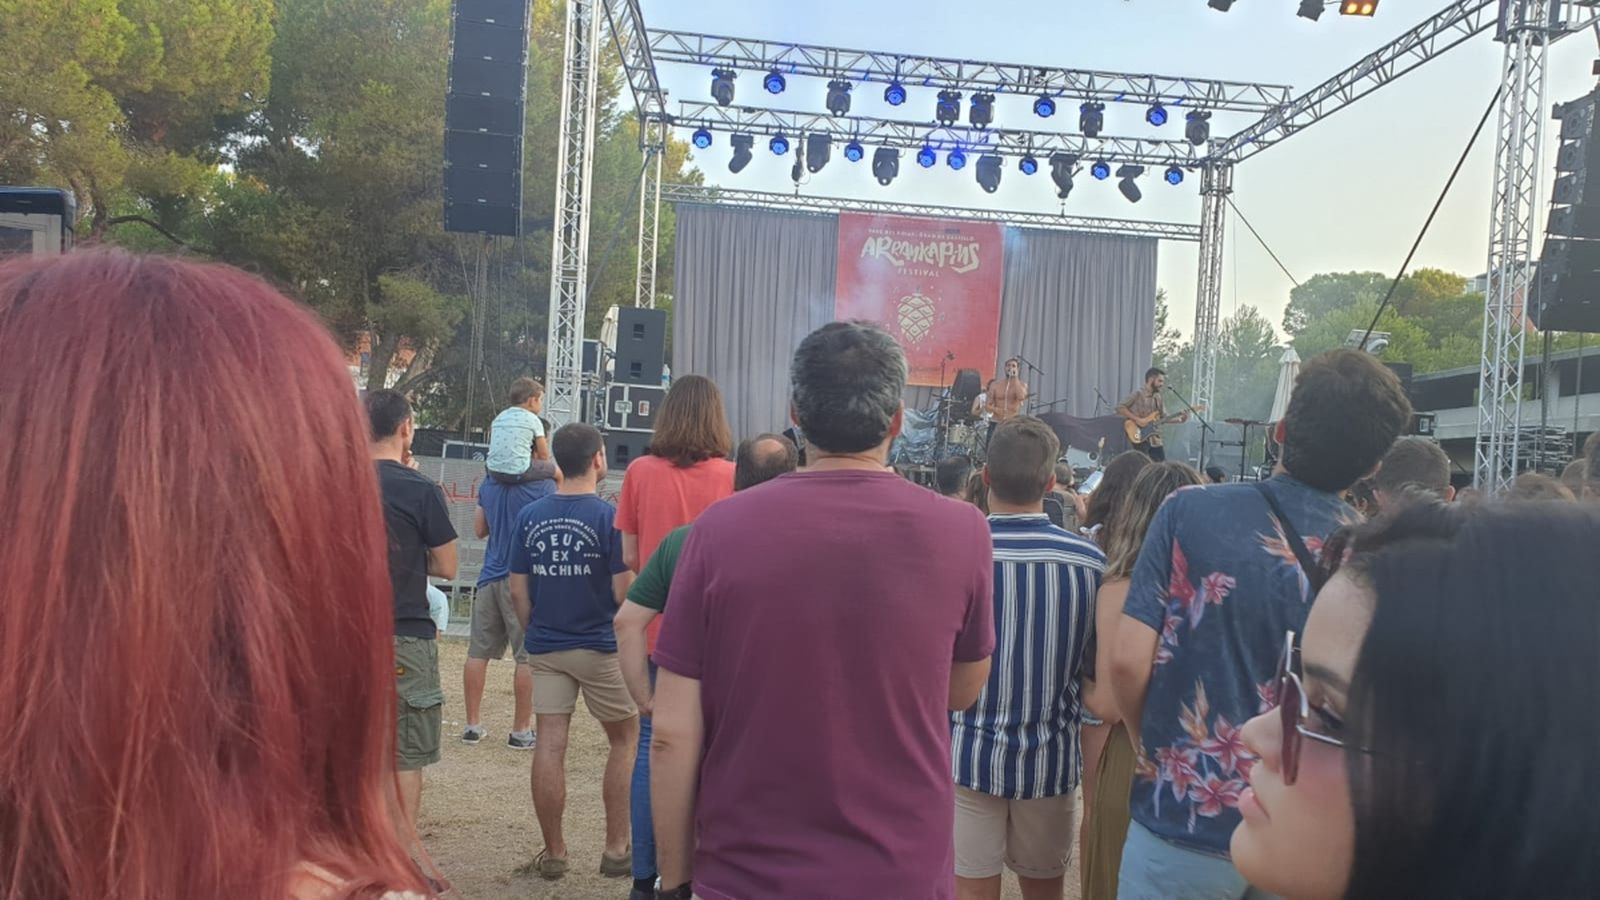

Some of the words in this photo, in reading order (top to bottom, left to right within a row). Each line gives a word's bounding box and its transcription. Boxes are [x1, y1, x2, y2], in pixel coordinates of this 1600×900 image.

[897, 267, 940, 278] FESTIVAL
[536, 533, 585, 553] DEUS
[552, 550, 569, 562] EX
[532, 564, 592, 577] MACHINA
